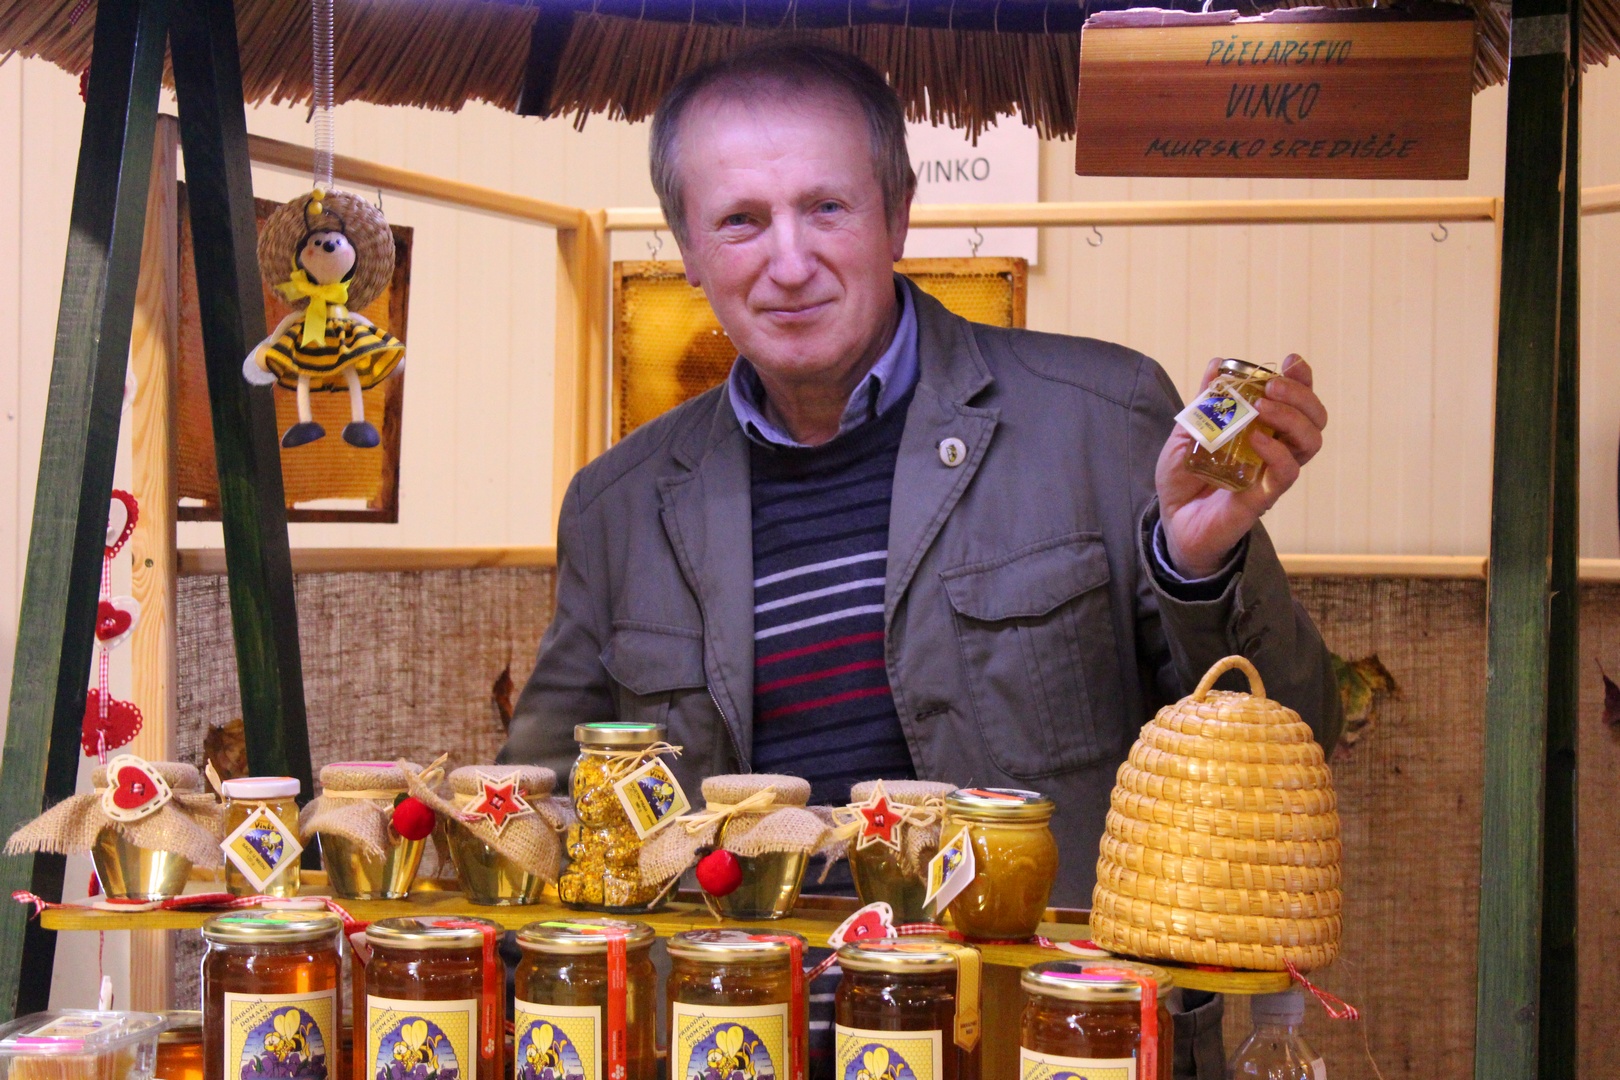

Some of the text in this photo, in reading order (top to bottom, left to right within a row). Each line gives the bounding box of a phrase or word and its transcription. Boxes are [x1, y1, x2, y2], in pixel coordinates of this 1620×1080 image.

[1205, 35, 1353, 66] PČELARSTVO
[1225, 82, 1321, 124] VINKO
[1144, 138, 1267, 158] MURSKO
